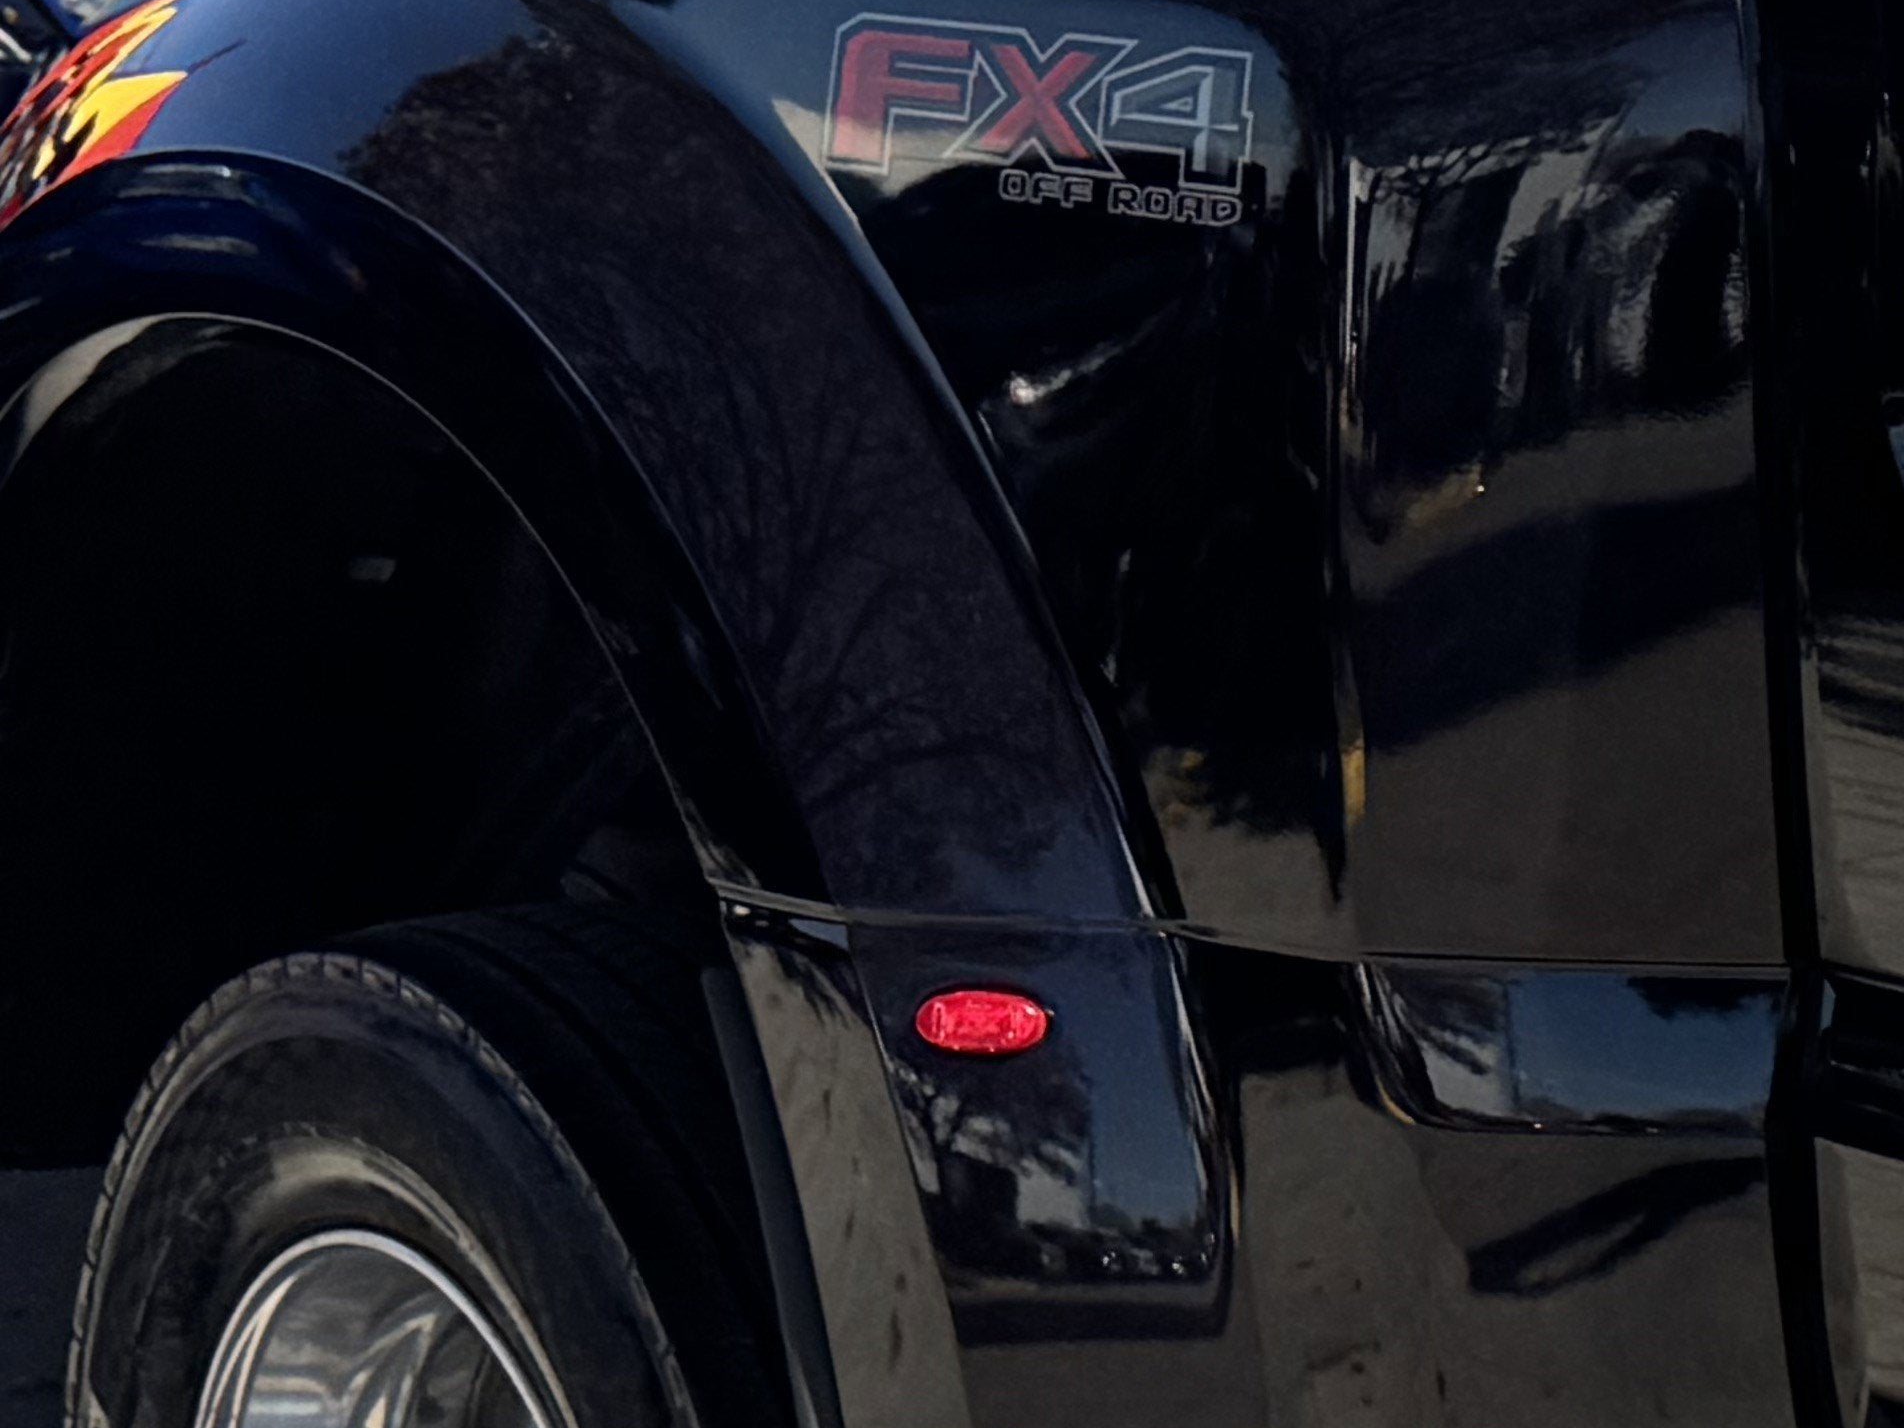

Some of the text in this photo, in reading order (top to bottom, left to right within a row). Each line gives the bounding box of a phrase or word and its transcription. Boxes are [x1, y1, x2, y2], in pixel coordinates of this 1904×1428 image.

[824, 12, 1253, 194] FX4
[1000, 170, 1244, 228] OFF ROAD
